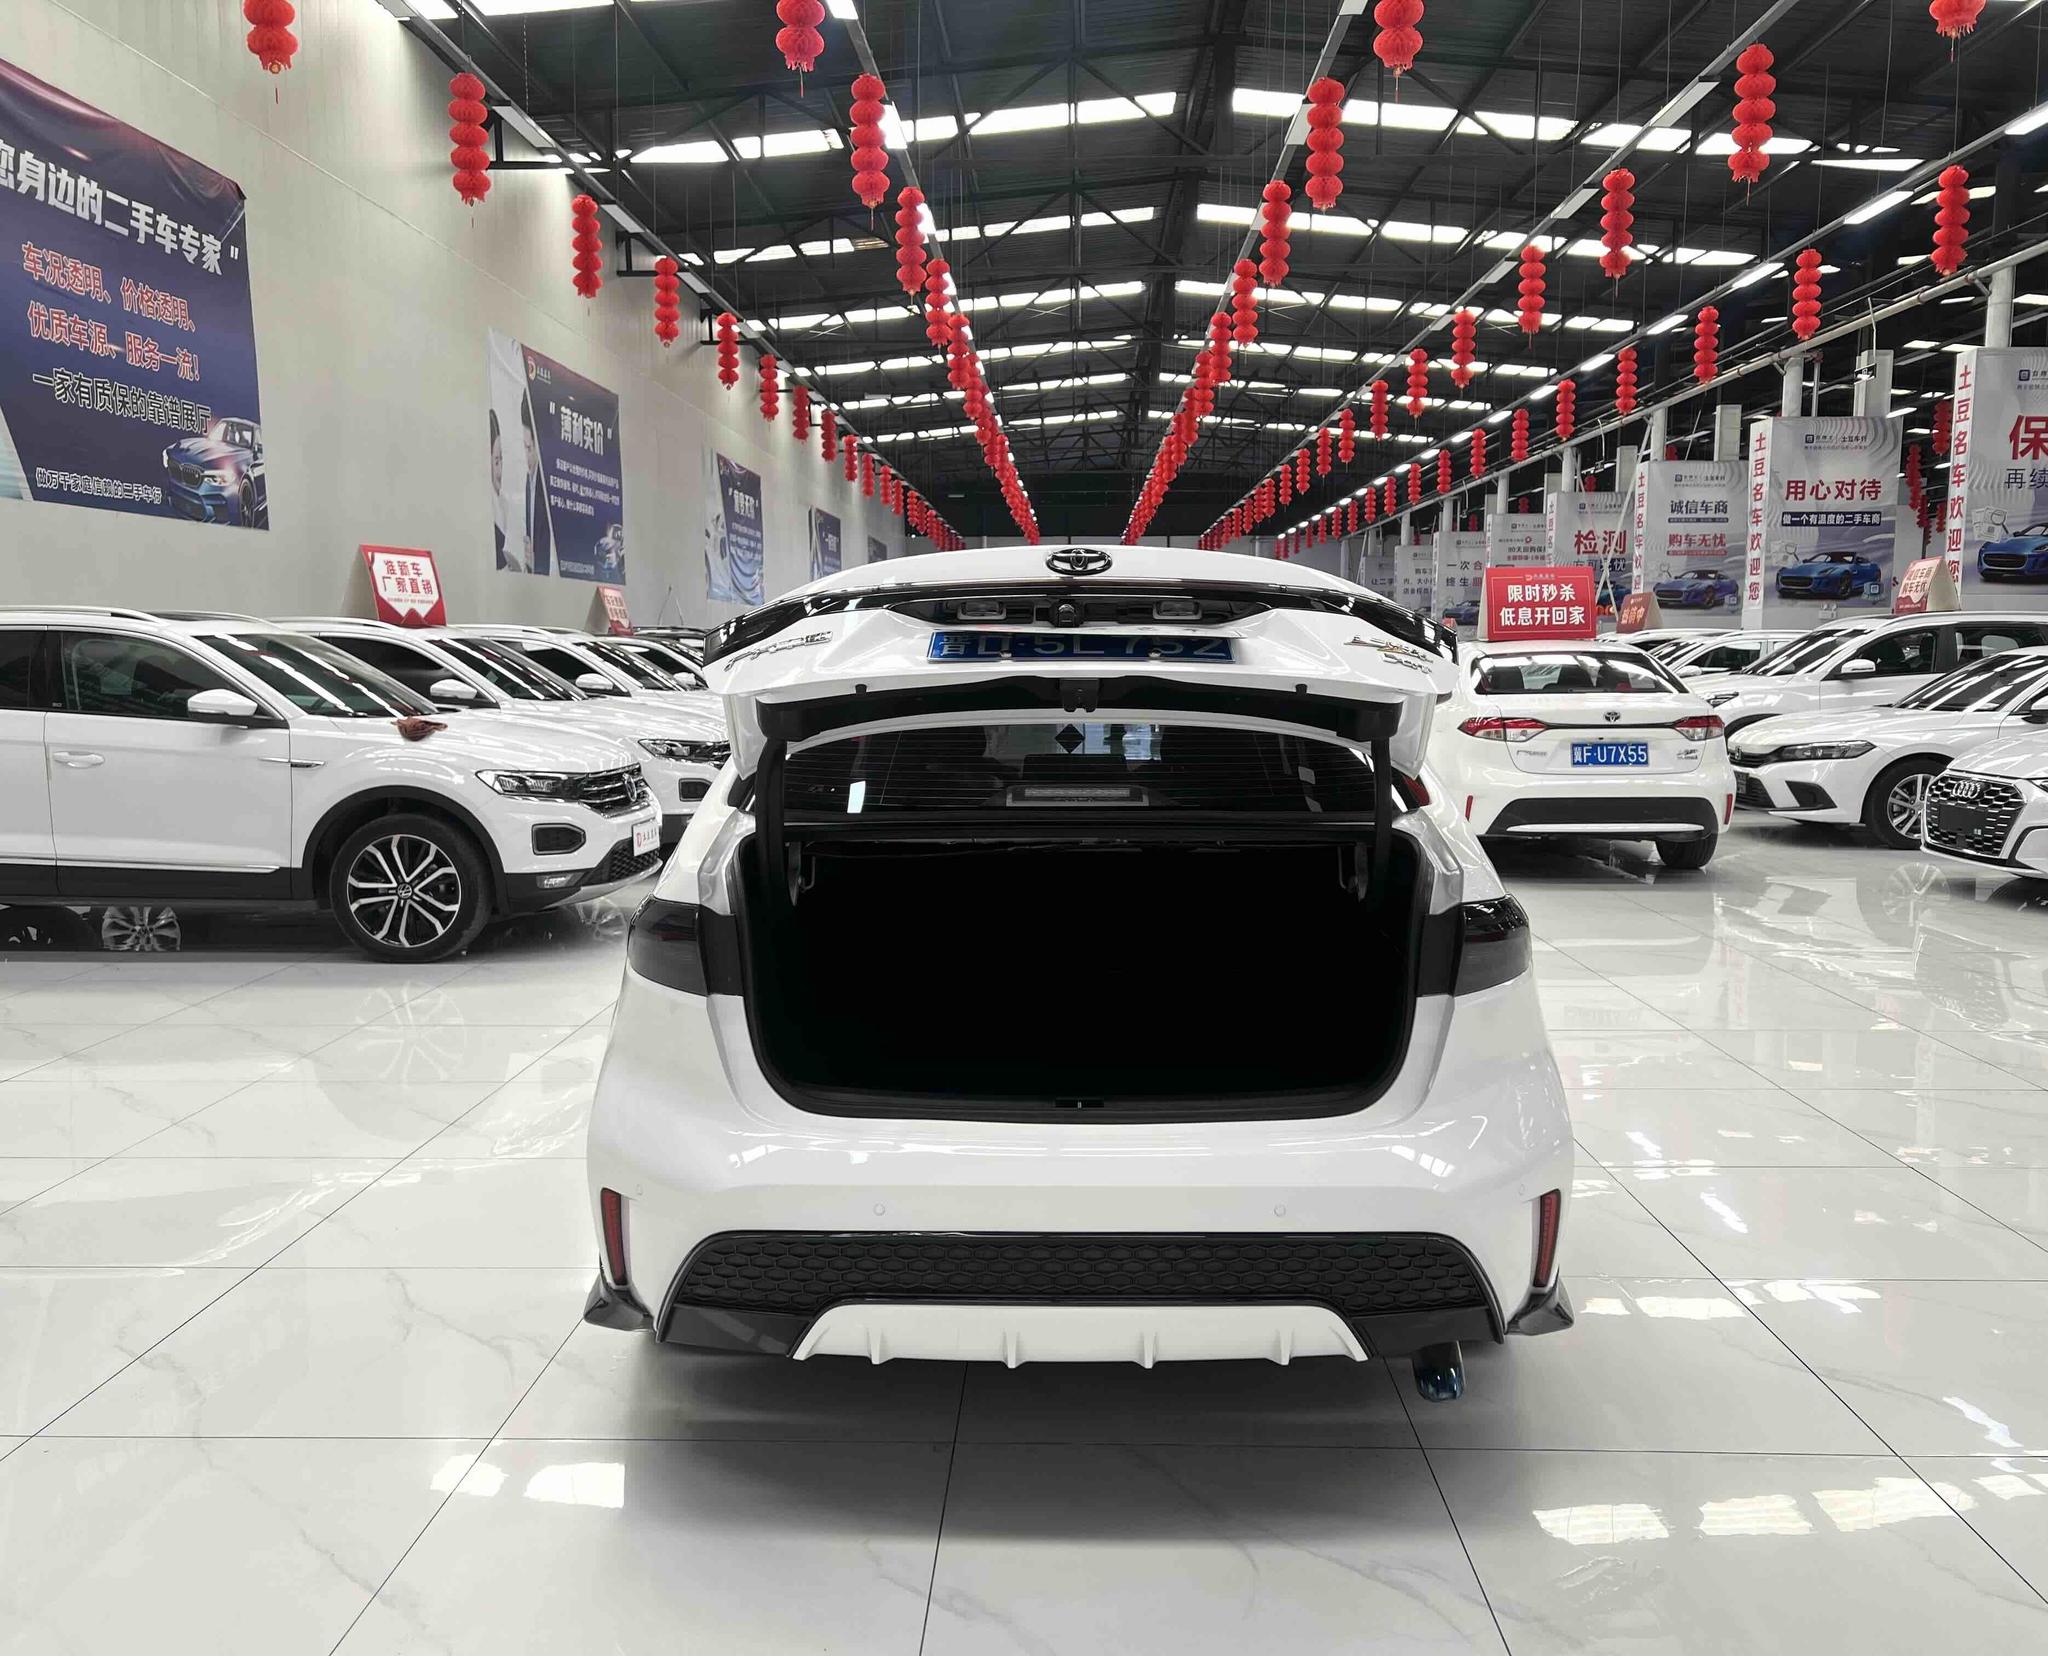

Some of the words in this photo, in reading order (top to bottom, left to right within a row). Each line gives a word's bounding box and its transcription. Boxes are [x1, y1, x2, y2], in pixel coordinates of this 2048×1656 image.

[33, 367, 211, 435] 一家有质保的靠谱展厅
[1785, 479, 1882, 501] 用心对待
[1670, 500, 1728, 514] 诚信车商
[1748, 432, 1767, 601] 土豆名车欢迎您
[1782, 513, 1880, 526] 做一个有温度的二手车商
[1574, 529, 1627, 555] 检测
[1669, 533, 1727, 547] 购车无忧
[1507, 583, 1576, 603] 限时秒杀
[1499, 606, 1585, 626] 低息开回家
